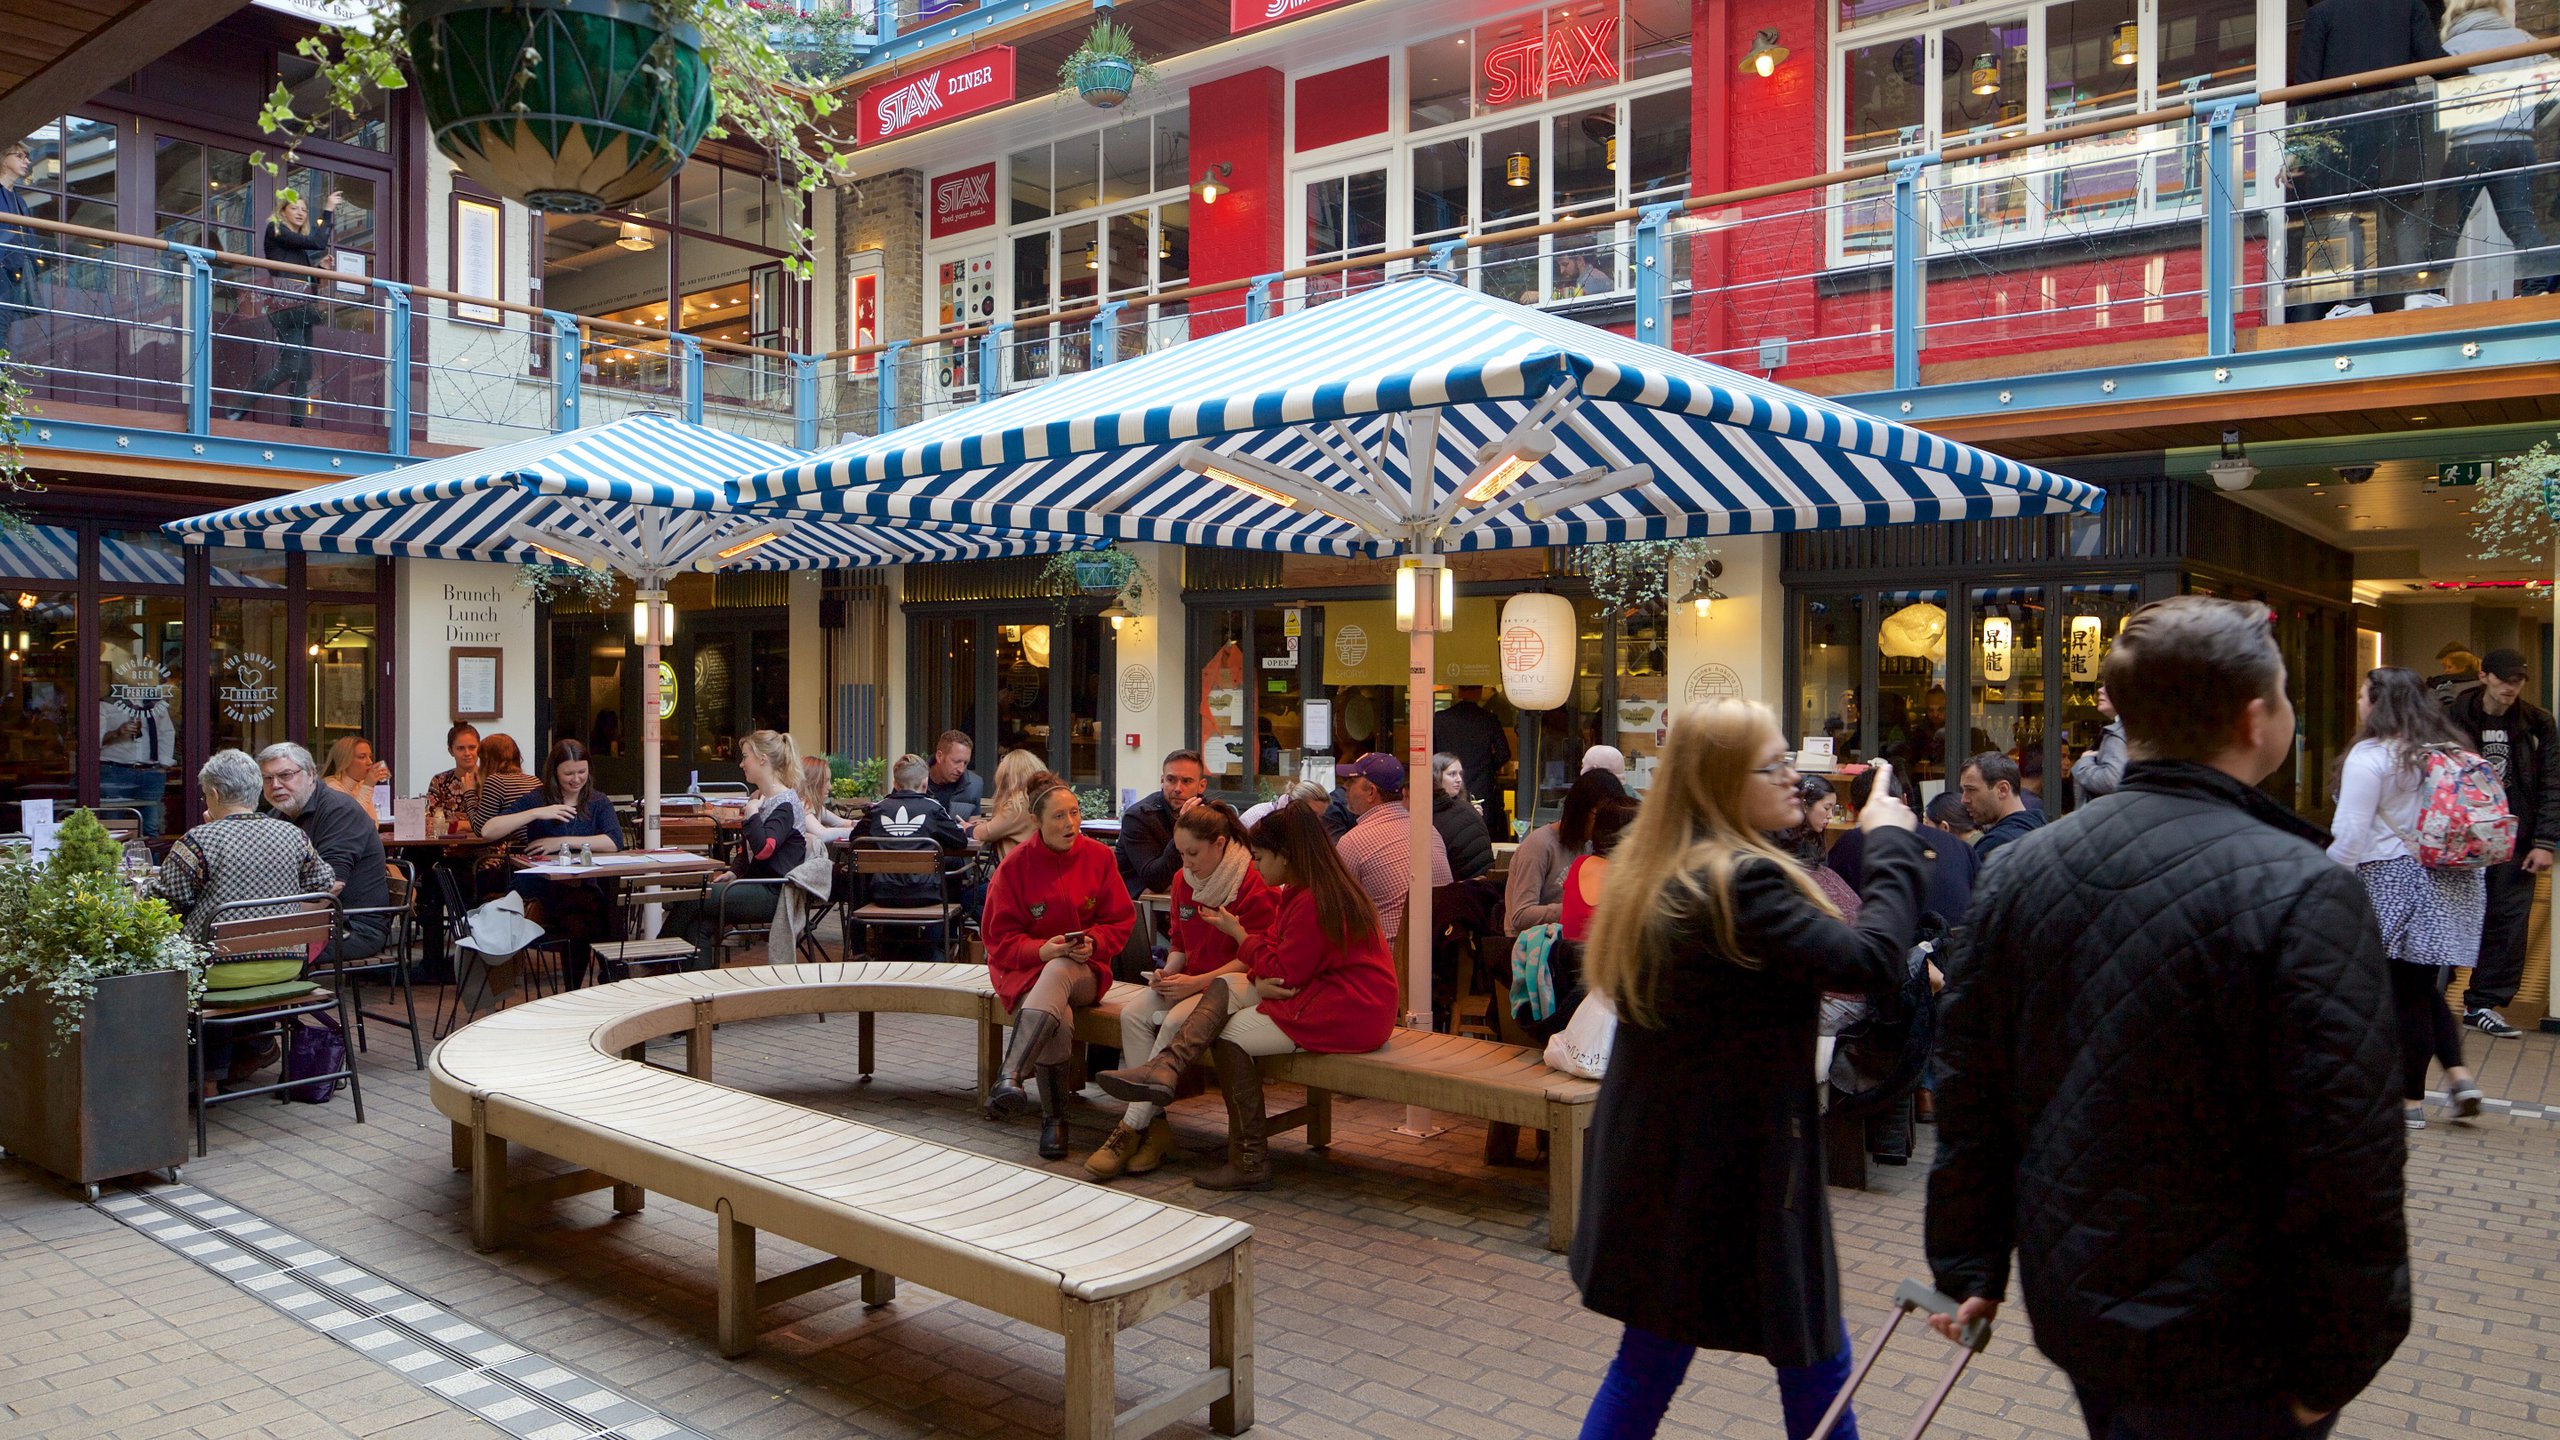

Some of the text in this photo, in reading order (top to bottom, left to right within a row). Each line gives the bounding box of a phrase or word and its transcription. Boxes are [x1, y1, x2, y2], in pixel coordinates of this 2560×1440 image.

[334, 5, 355, 19] Bar
[1484, 16, 1619, 104] STAX
[878, 66, 993, 135] STAX DINER
[937, 172, 990, 214] STAX
[941, 214, 954, 224] feed
[954, 212, 969, 222] your
[443, 583, 501, 602] Brunch
[449, 604, 497, 622] Lunch
[446, 625, 501, 642] Dinner
[115, 659, 171, 678] CHICKEN AND
[223, 652, 277, 671] OUR SUNDAY
[1267, 659, 1289, 667] OPEN
[132, 670, 153, 680] BEER
[1693, 667, 1711, 681] bones
[1714, 666, 1736, 684] hakata
[126, 688, 158, 697] PERFECT
[236, 690, 262, 699] ROAST
[223, 705, 275, 723] THAN YOURS
